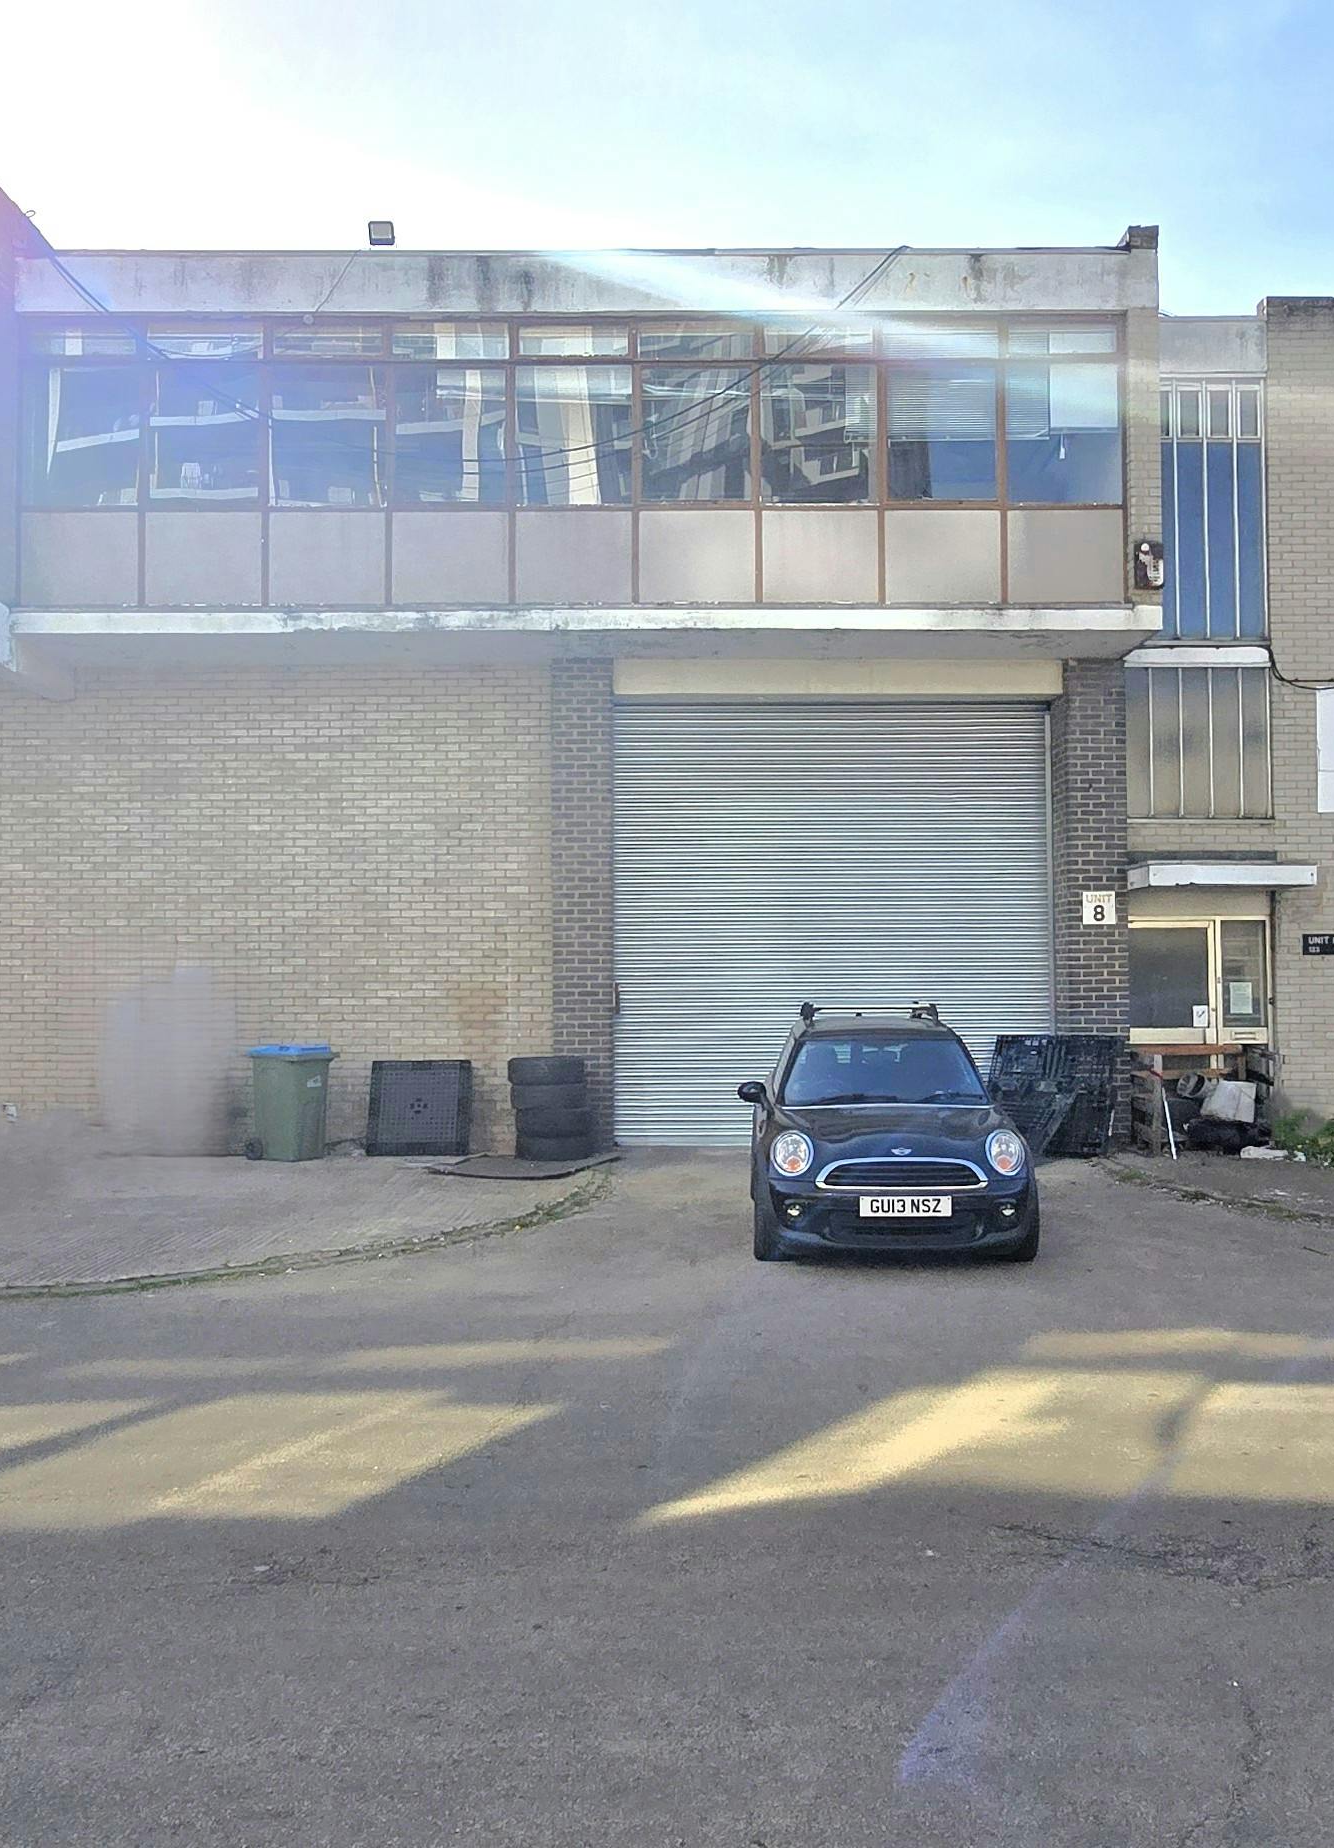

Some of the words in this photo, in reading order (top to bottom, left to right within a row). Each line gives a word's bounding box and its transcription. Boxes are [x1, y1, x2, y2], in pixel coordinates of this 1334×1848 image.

[1085, 894, 1113, 904] UNIT
[1093, 904, 1106, 922] 8
[1308, 935, 1330, 945] UNIT
[870, 1198, 906, 1214] GU13
[910, 1198, 942, 1213] NSZ
